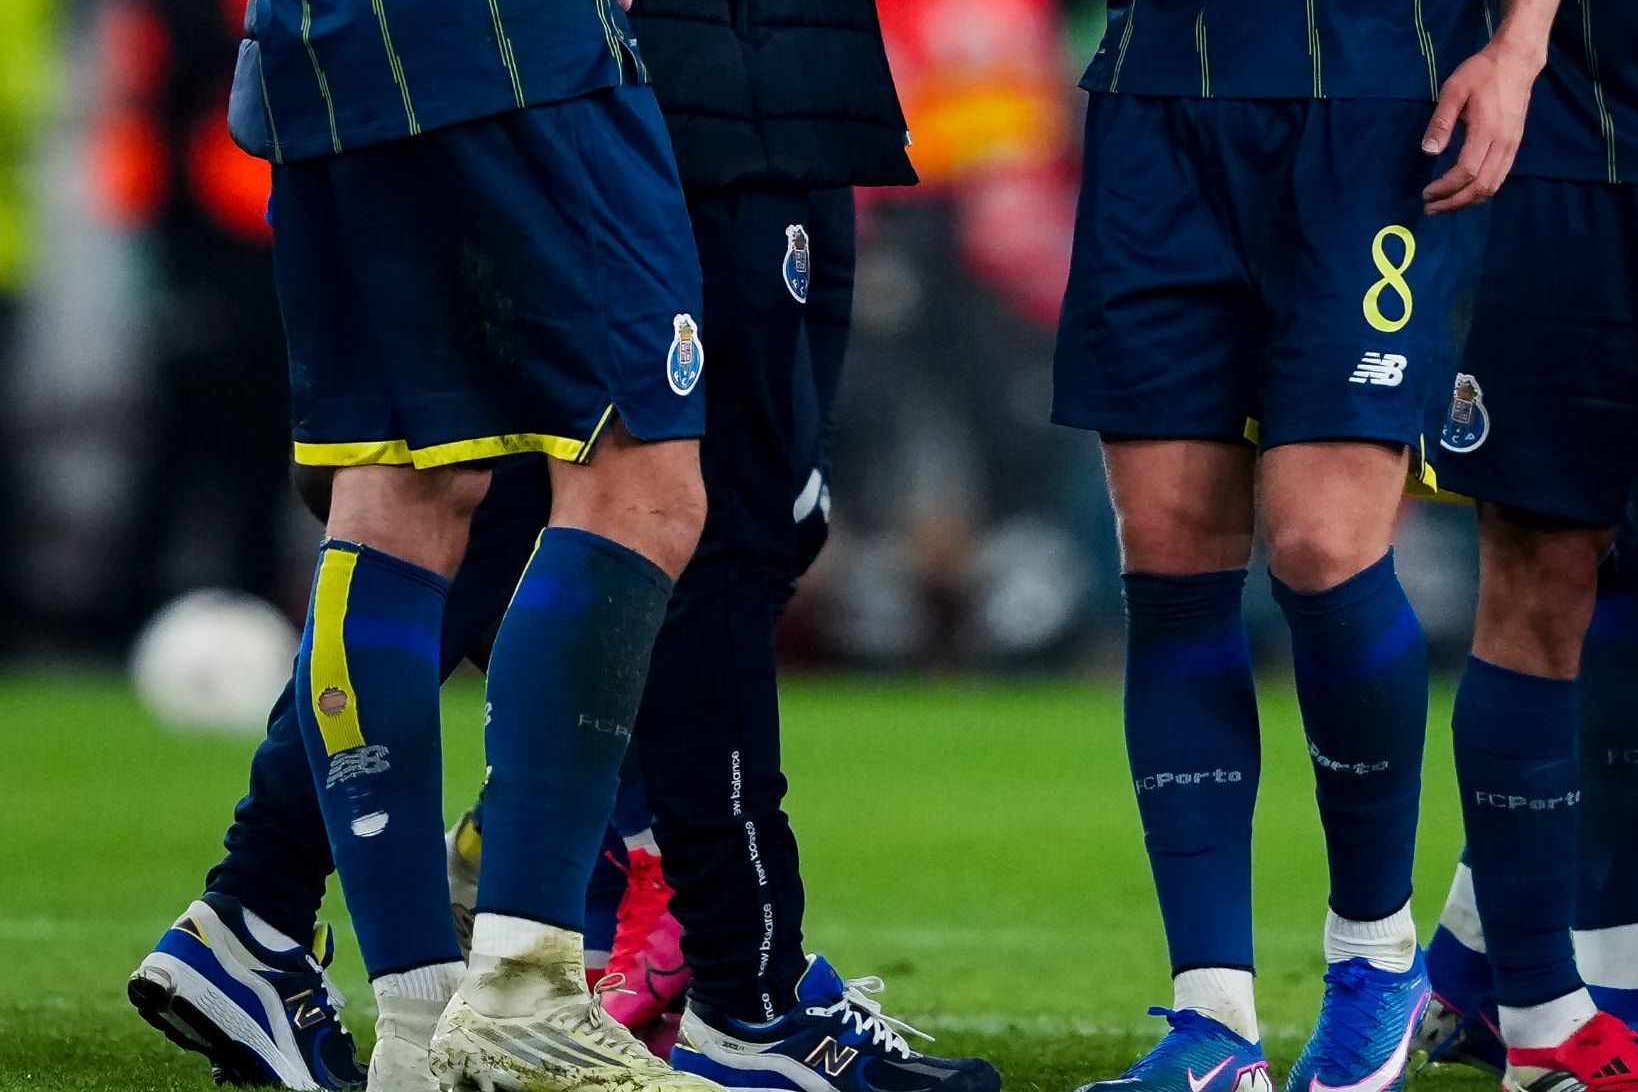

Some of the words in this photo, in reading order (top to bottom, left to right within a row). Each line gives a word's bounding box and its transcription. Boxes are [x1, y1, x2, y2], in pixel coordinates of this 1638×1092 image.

[1362, 224, 1417, 333] 8
[730, 750, 742, 799] balance
[803, 1035, 859, 1077] N
